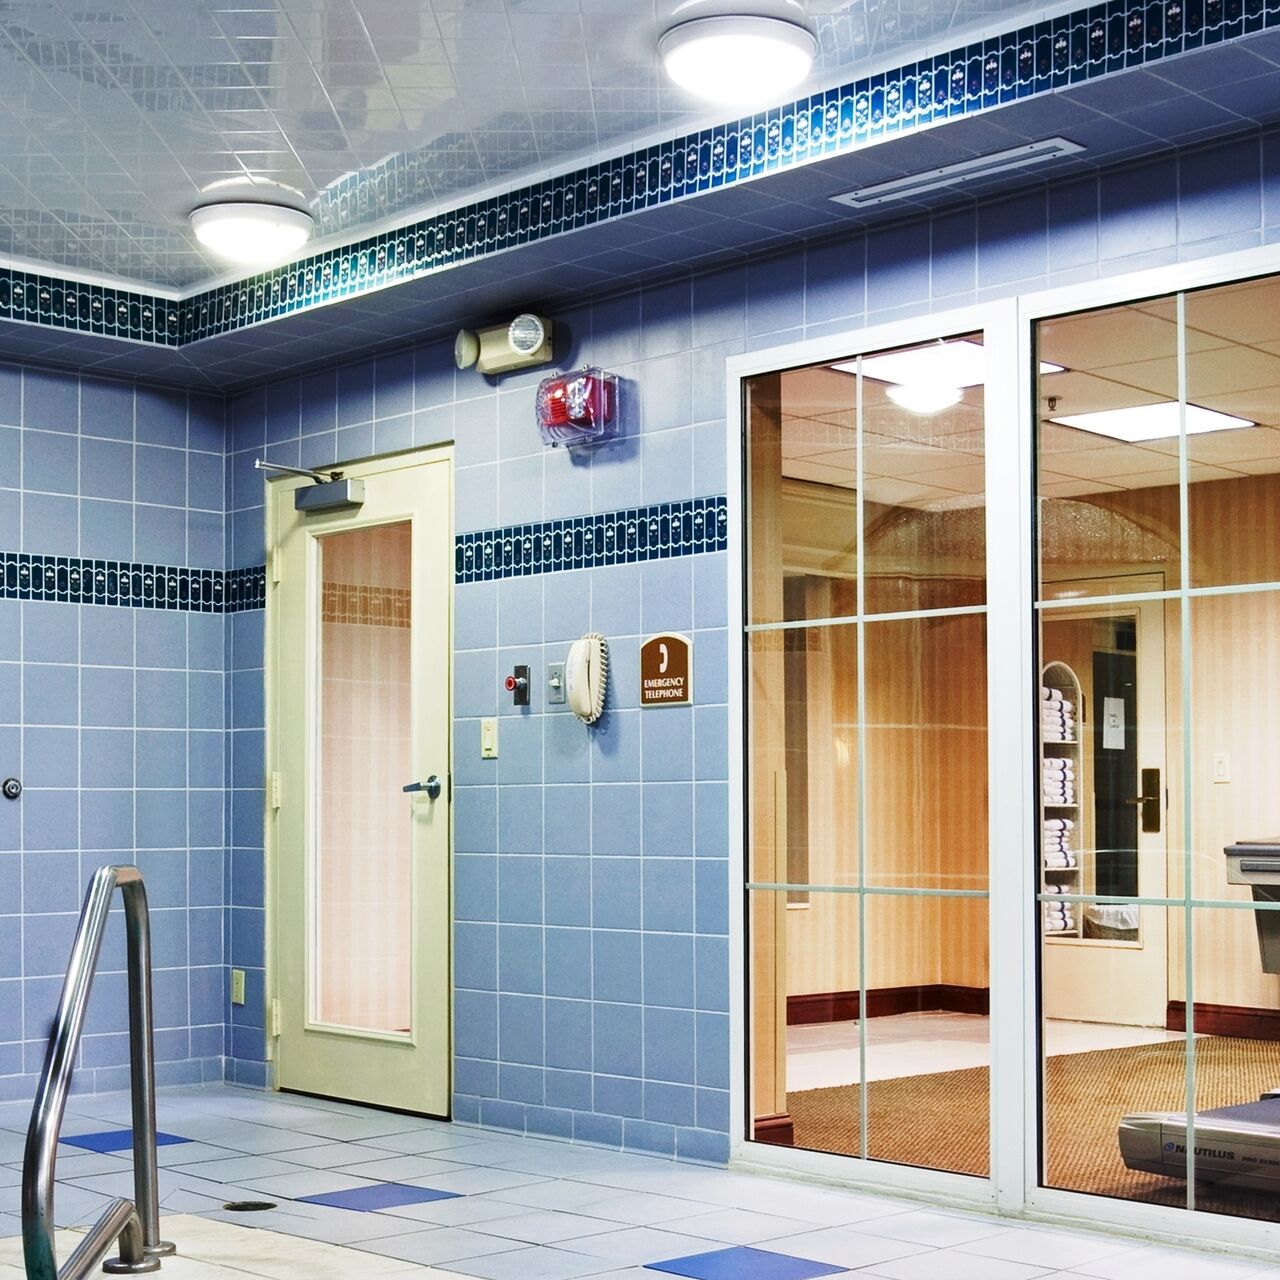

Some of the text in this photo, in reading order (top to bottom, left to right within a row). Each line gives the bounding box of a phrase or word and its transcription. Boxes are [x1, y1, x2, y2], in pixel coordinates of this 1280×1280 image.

[644, 677, 684, 688] EMERGENCY
[645, 688, 683, 698] TELEPHONE
[1176, 1145, 1234, 1160] NUTILUS
